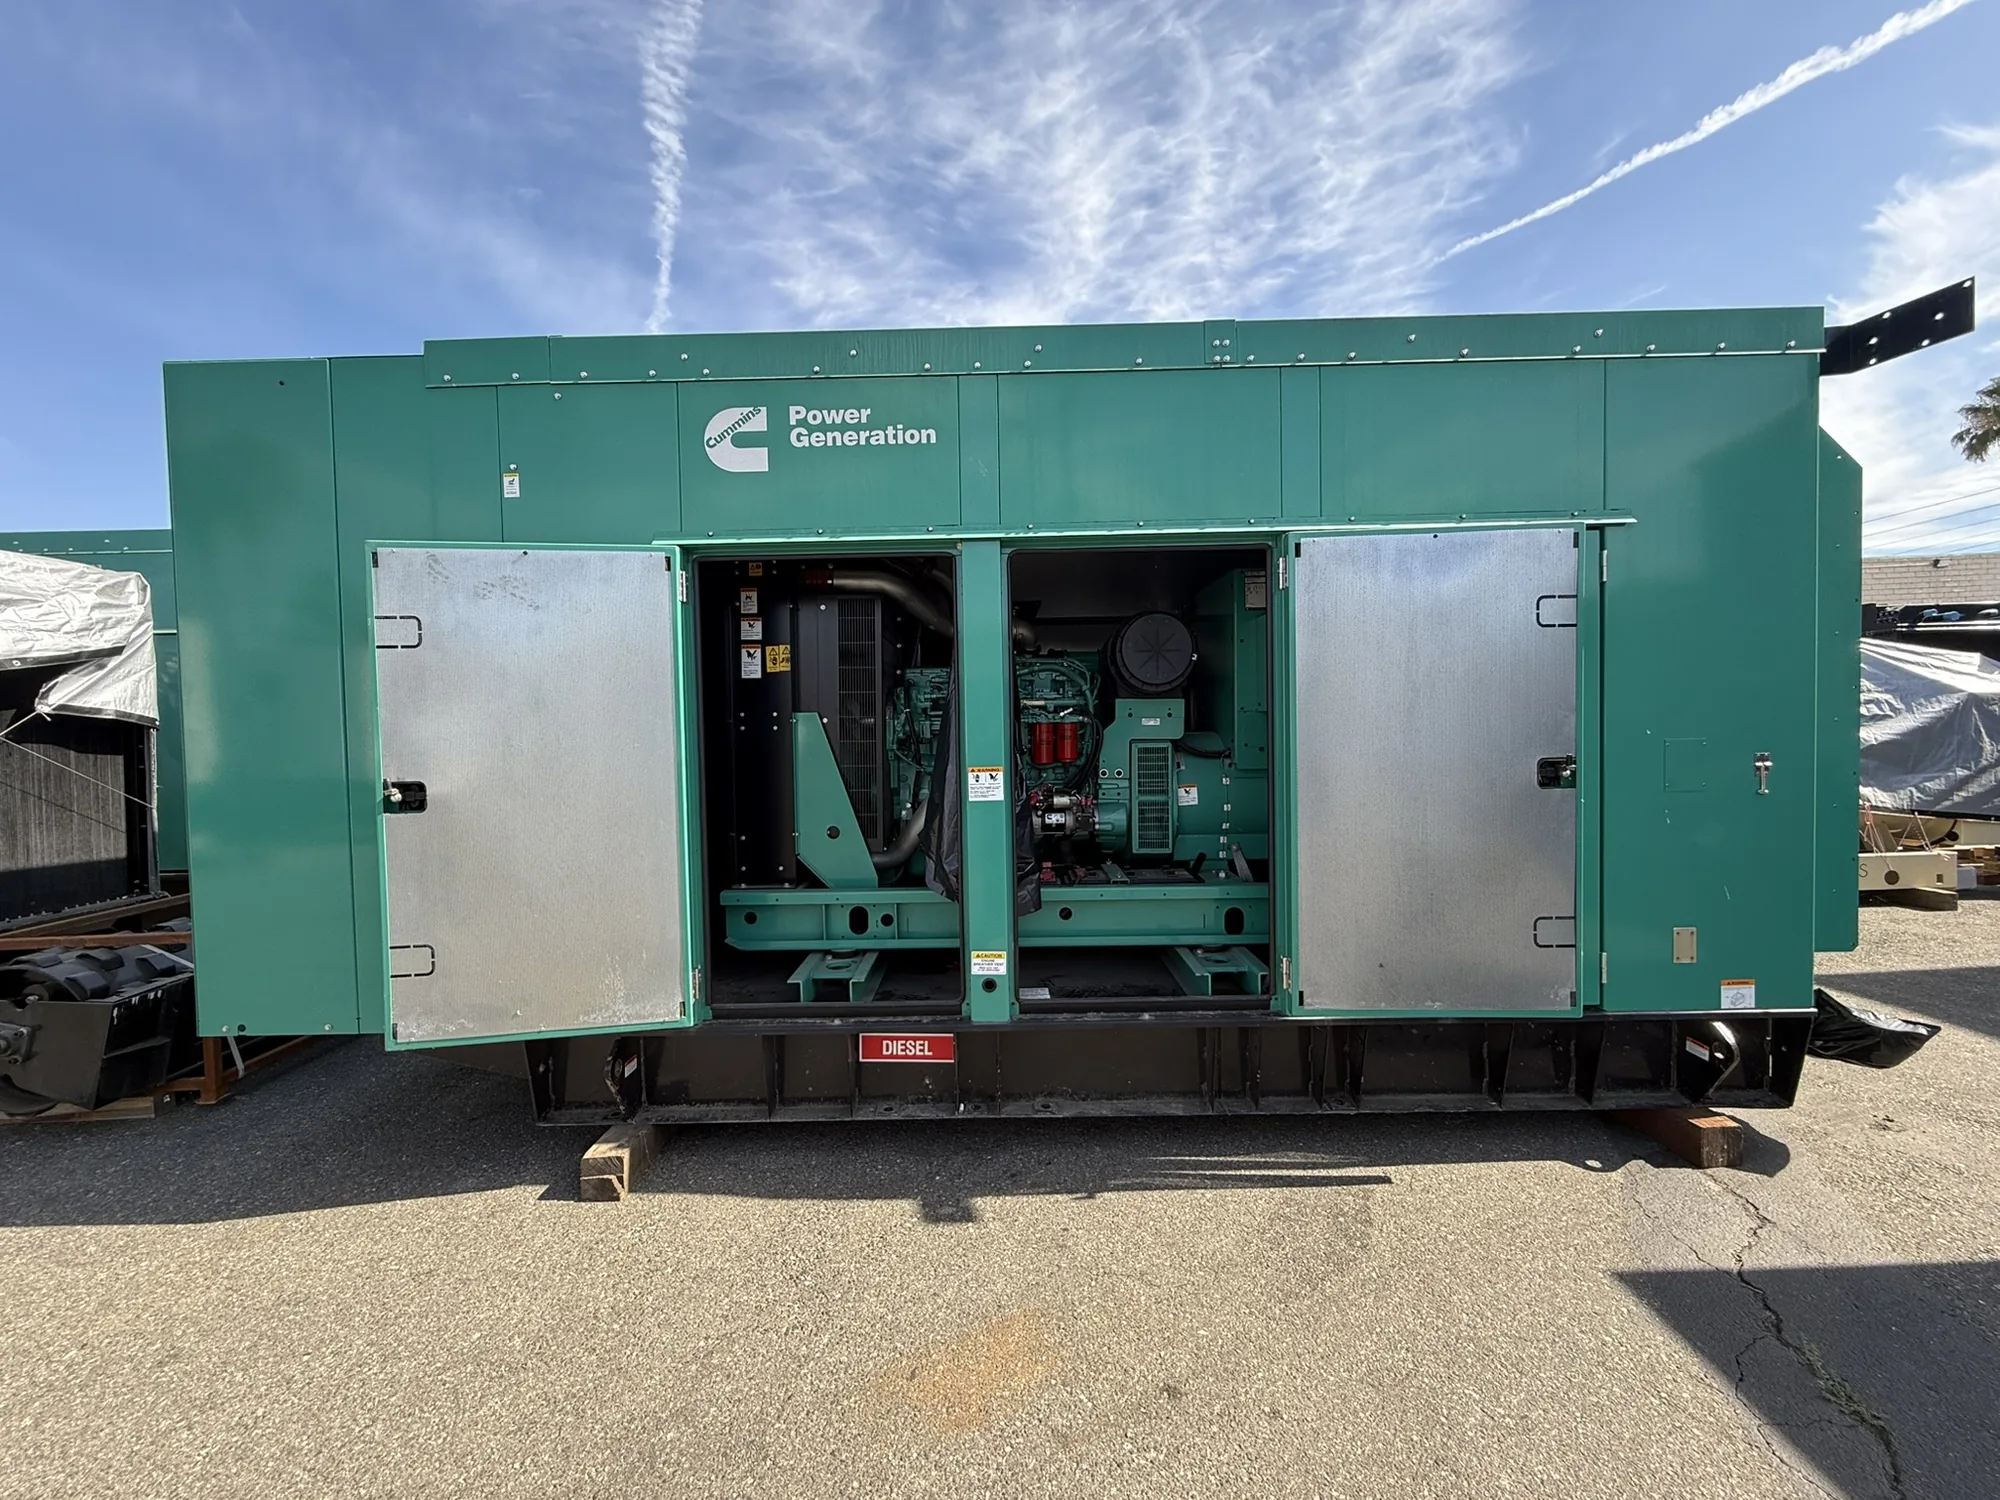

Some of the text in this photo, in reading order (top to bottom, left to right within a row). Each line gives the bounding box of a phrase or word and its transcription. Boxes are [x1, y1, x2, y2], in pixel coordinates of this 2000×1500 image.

[789, 405, 870, 425] Power
[706, 407, 761, 448] Cummins
[790, 425, 936, 447] Generation
[882, 1040, 933, 1055] DIESEL
